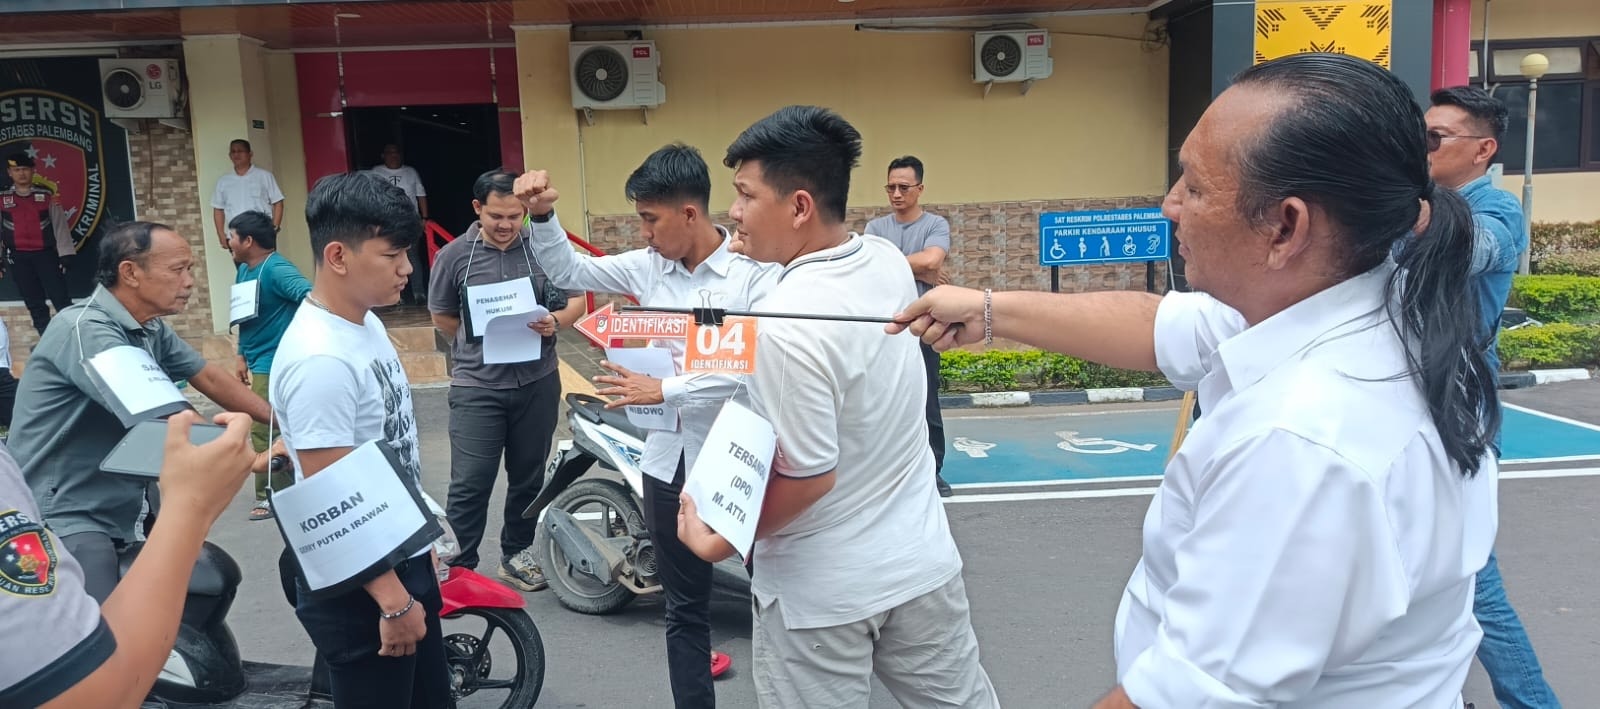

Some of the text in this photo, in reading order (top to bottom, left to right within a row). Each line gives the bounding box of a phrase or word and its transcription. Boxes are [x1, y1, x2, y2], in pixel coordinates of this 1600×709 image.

[149, 81, 162, 90] LG
[37, 125, 93, 153] PALEMBANG
[74, 162, 100, 237] KRIMINAL
[1054, 216, 1066, 225] SAT
[1093, 213, 1132, 222] POLRESTABES
[1054, 225, 1156, 236] PARKIR KENDARAAN KHUSUS
[476, 292, 518, 305] PENASEHAT
[485, 305, 513, 315] HUKUM
[610, 317, 686, 335] IDENTIFIKASI
[695, 322, 746, 356] 04
[690, 358, 749, 370] IDENTIFIKASI
[730, 475, 753, 500] (DPO)
[298, 491, 365, 533] KORBAN
[711, 491, 747, 525] M. ATTA
[317, 527, 350, 548] PUTRA
[350, 502, 389, 530] IRAWAN
